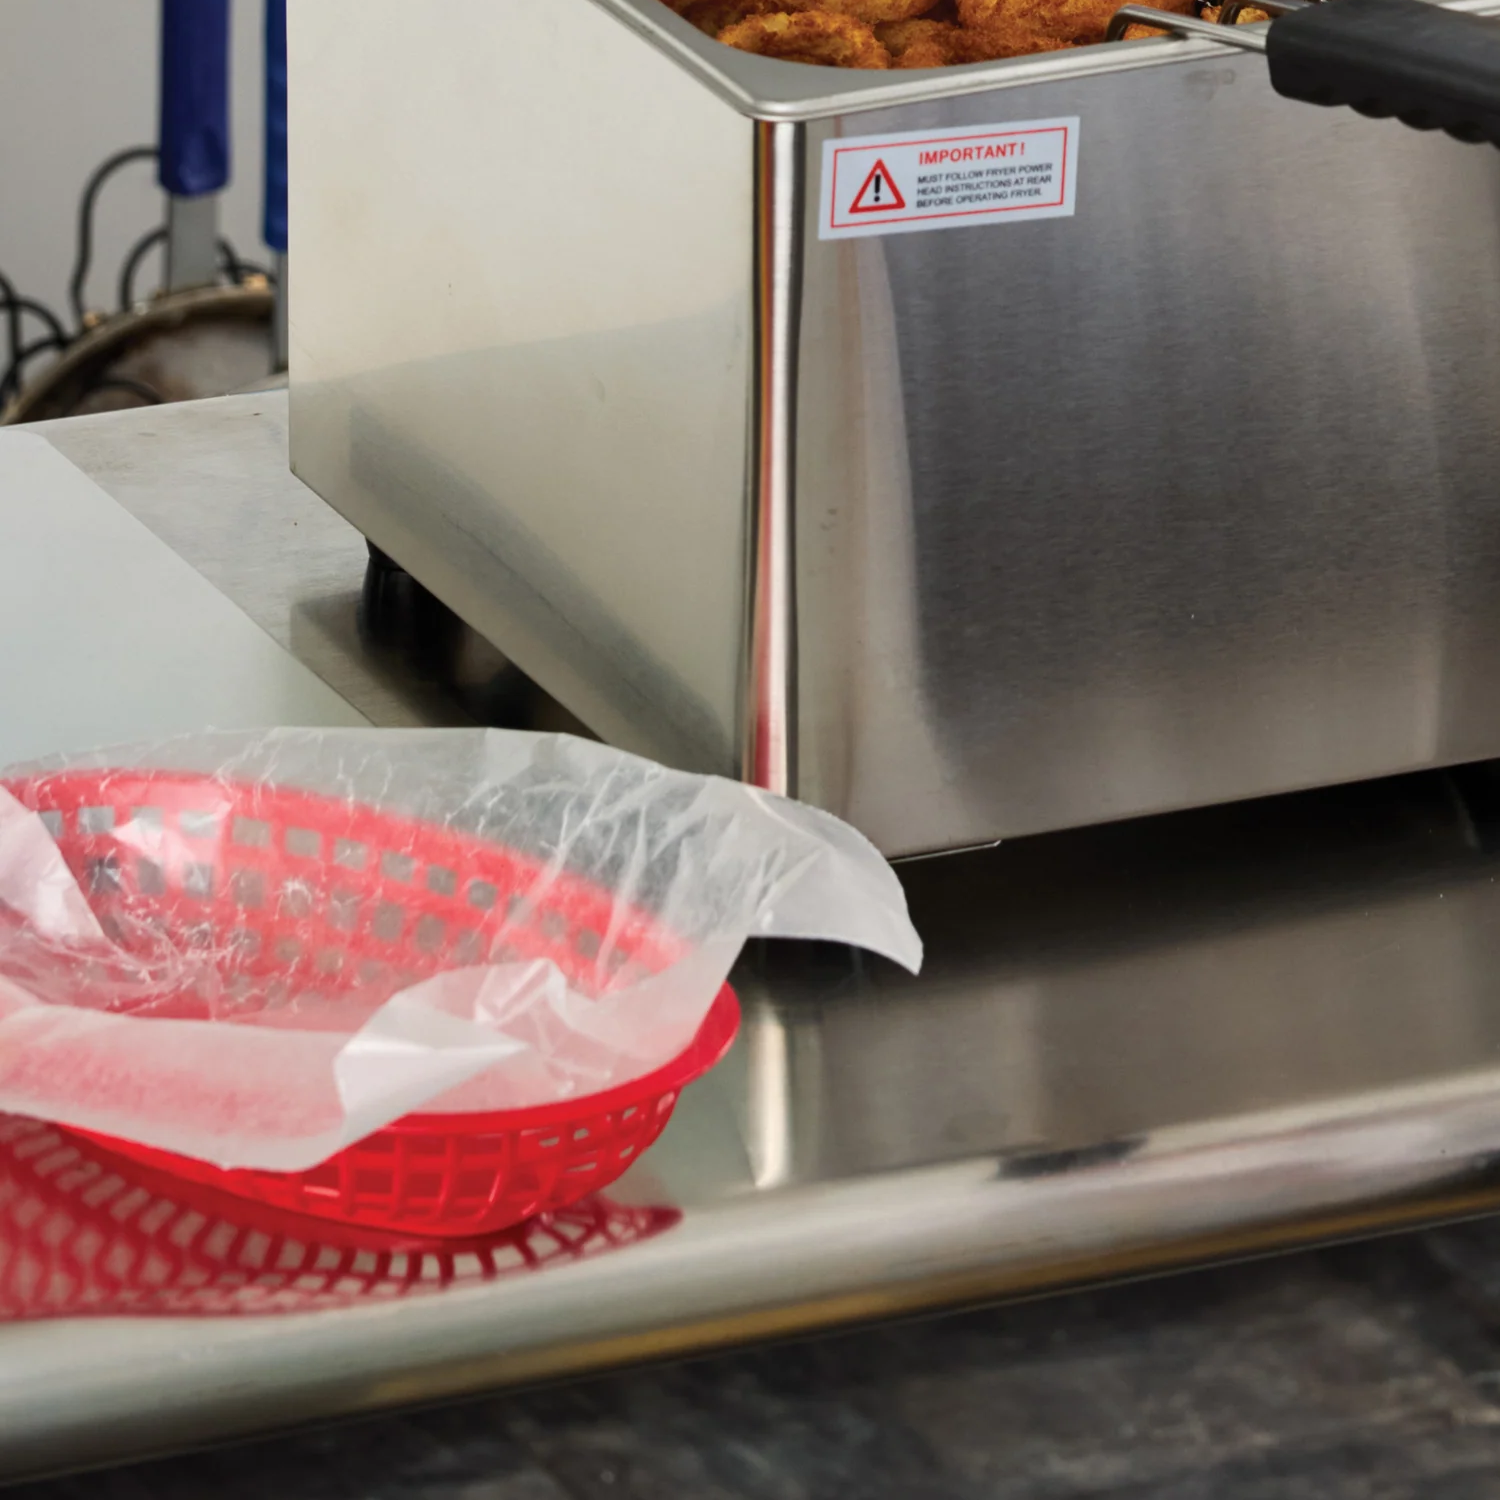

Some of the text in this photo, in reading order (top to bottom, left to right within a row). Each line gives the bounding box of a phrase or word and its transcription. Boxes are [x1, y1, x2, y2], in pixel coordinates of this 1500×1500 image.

[918, 163, 1053, 184] MUST FOLLOW FRYER POWER
[917, 175, 1052, 195] HEAD INSTRUCTIONS AT REAR
[916, 188, 1041, 208] BEFORE OPERATING FRYER.
